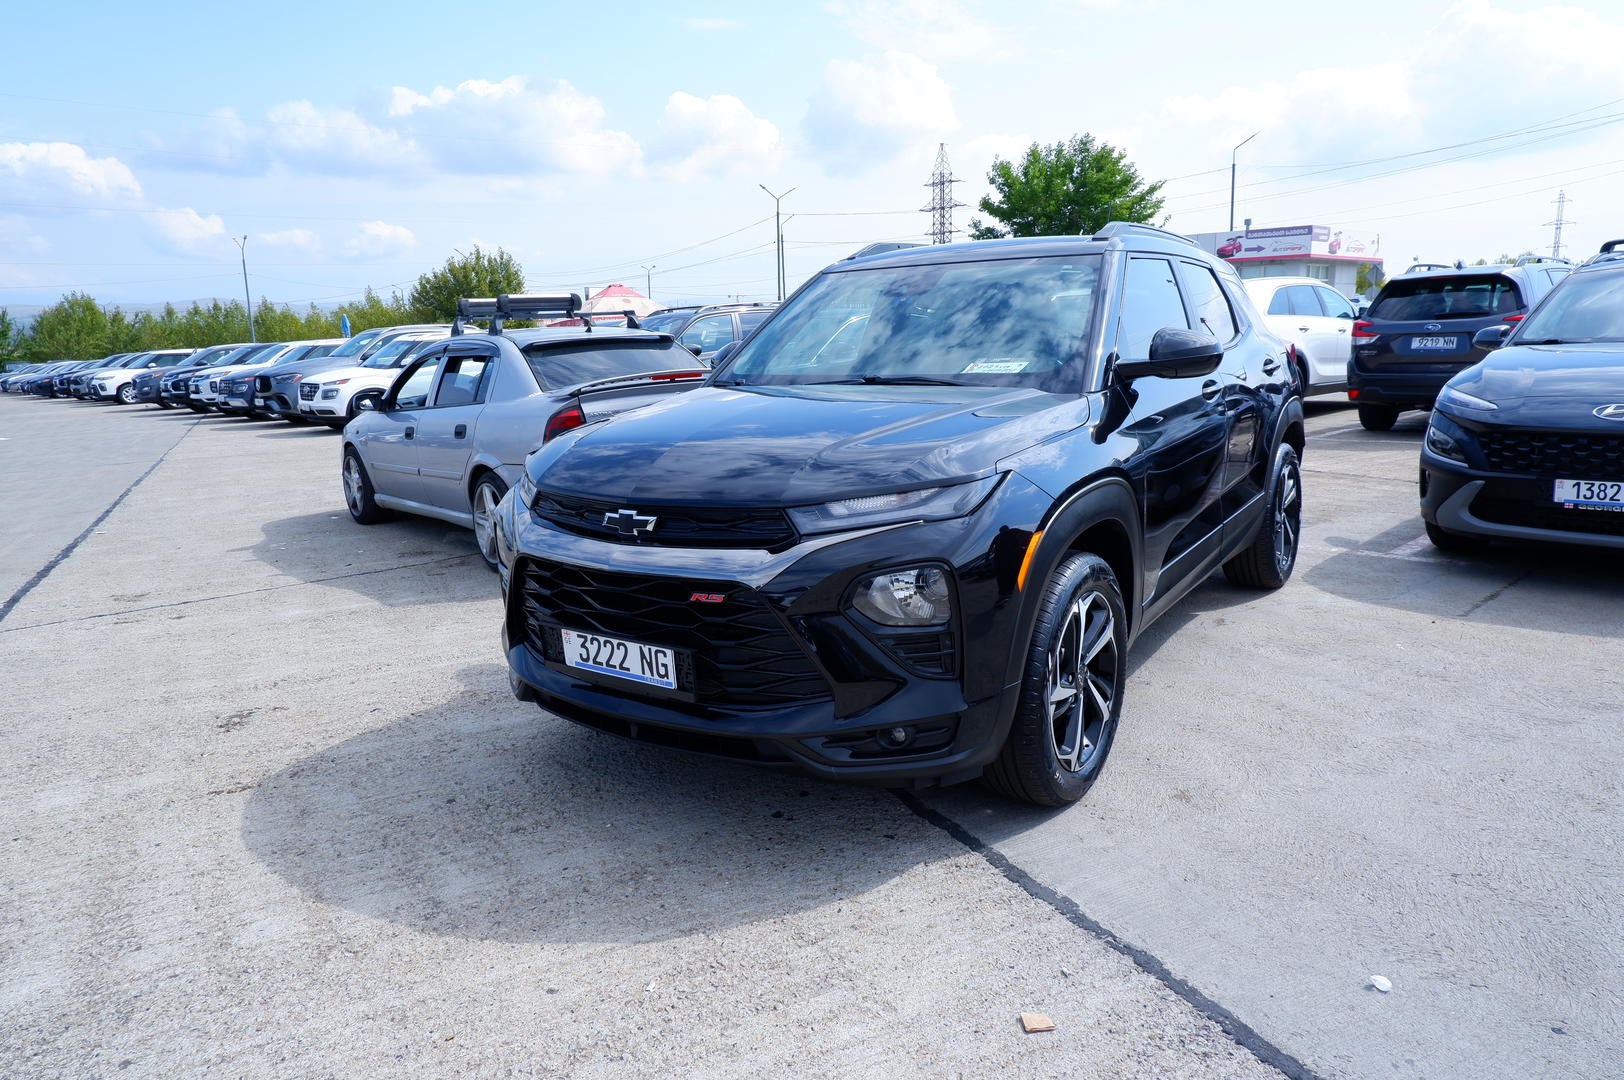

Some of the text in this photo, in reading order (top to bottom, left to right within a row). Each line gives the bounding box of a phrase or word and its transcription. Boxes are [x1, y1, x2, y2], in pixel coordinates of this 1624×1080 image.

[1418, 338, 1455, 346] 9219 NN
[1572, 481, 1622, 502] 1382
[690, 593, 725, 603] RS
[576, 633, 669, 680] 3222 NG
